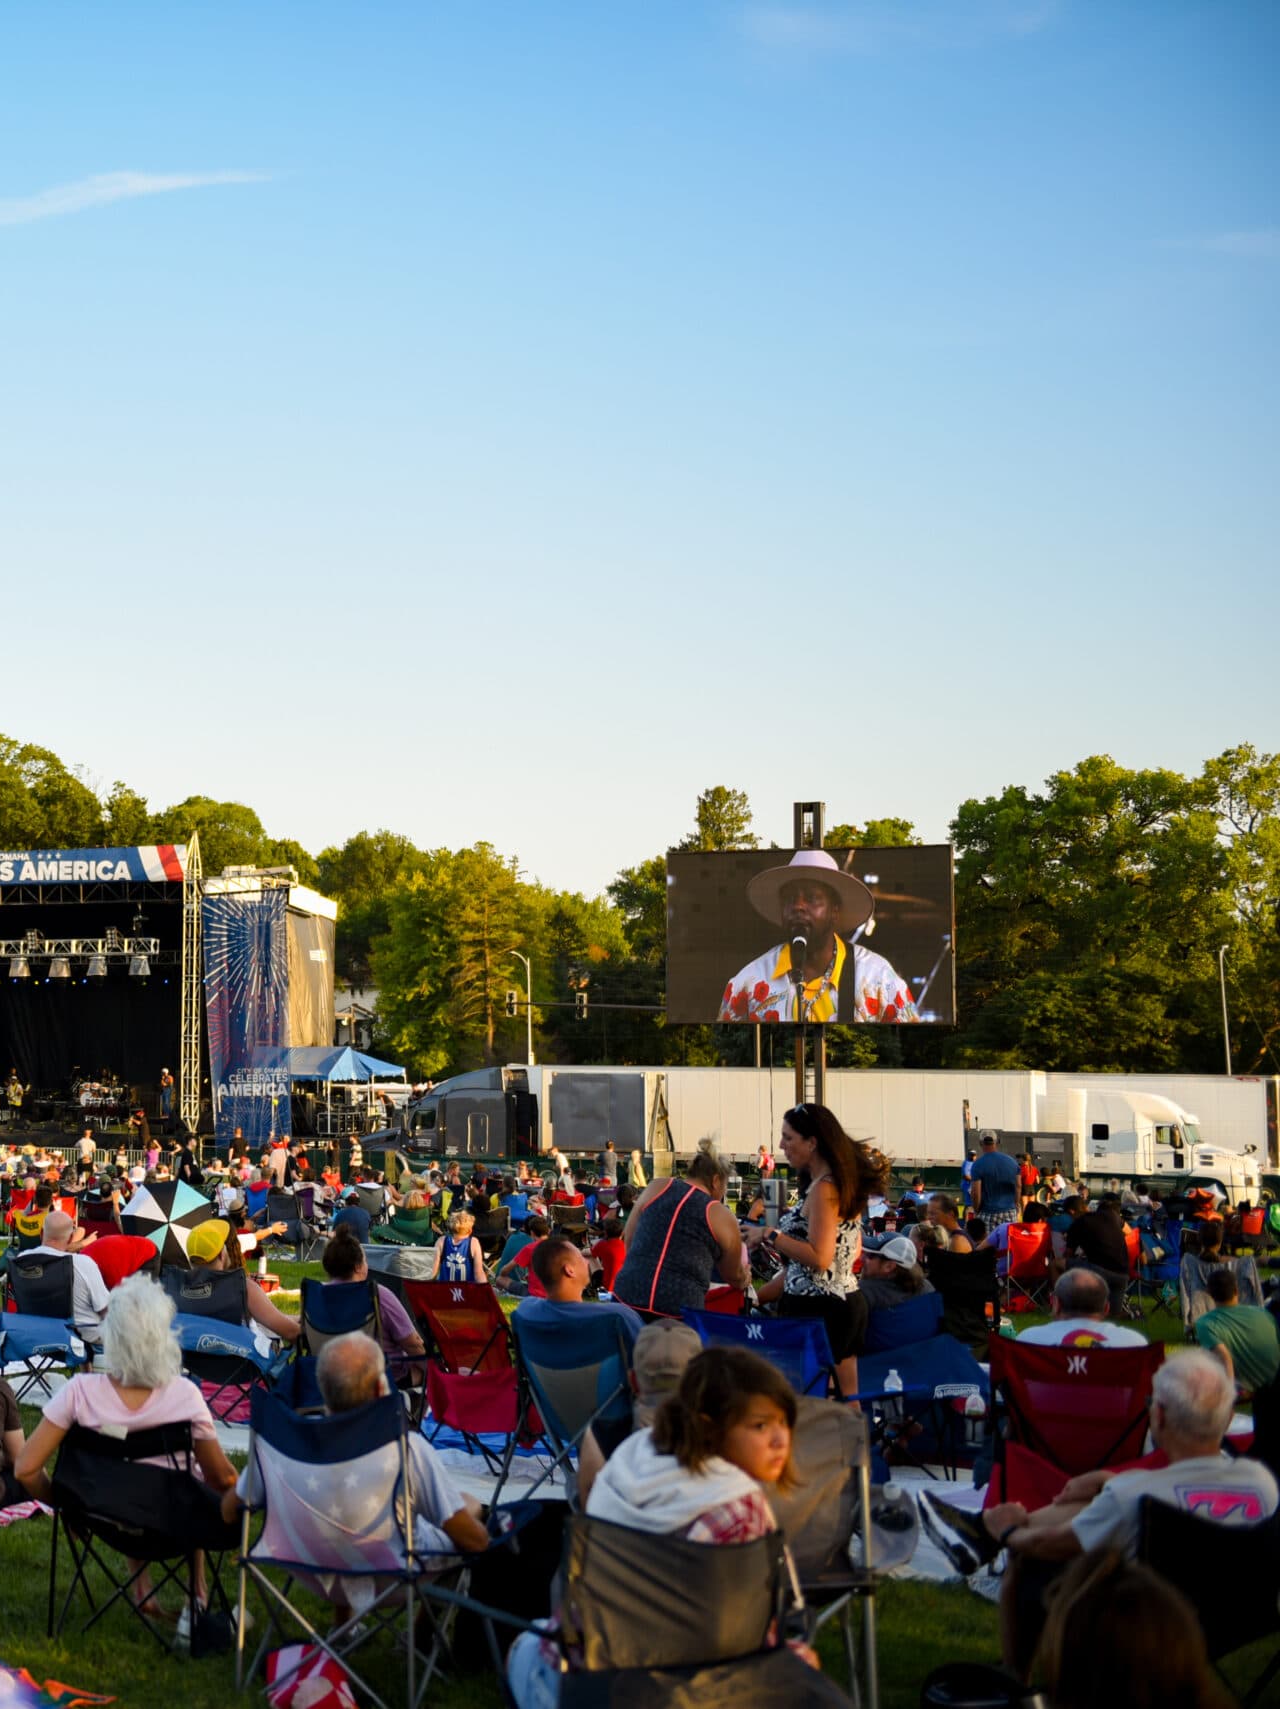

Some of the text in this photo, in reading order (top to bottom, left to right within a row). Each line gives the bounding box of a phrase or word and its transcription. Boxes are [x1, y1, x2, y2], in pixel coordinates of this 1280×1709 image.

[19, 860, 132, 881] AMERICA
[228, 1073, 289, 1083] CELEBRATES
[217, 1082, 289, 1097] AMERICA
